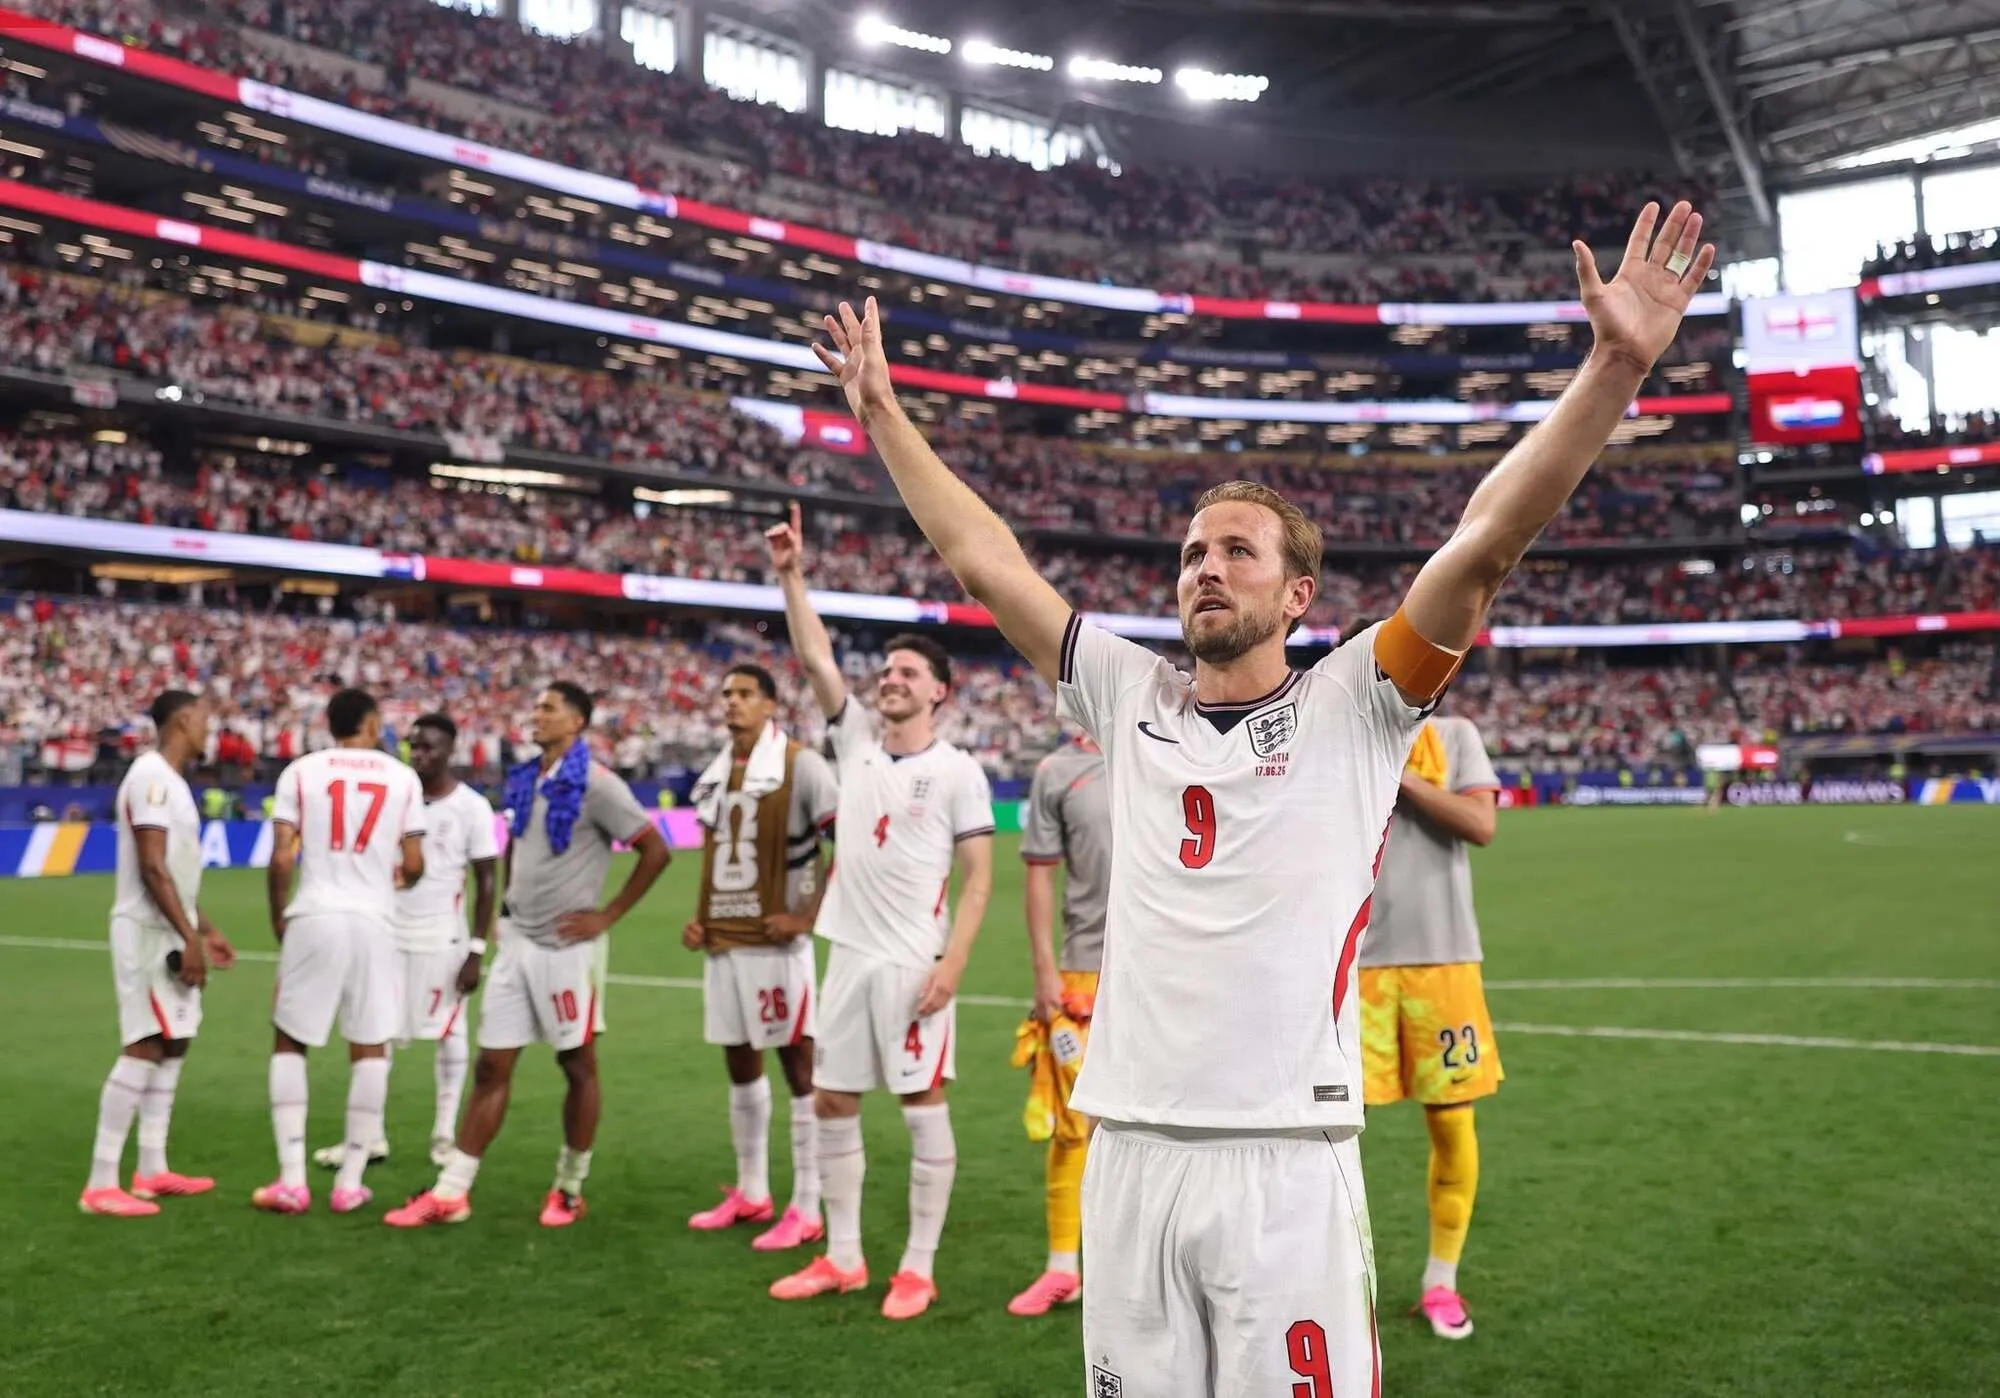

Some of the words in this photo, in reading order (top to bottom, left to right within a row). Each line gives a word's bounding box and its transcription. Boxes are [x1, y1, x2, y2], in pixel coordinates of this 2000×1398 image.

[327, 779, 388, 853] 17
[873, 813, 890, 849] 4
[1178, 784, 1217, 869] 9
[428, 987, 442, 1018] 7
[551, 988, 578, 1024] 10
[757, 986, 789, 1025] 26
[904, 1019, 923, 1062] 4
[1439, 1025, 1478, 1068] 23
[1285, 1319, 1333, 1398] 9
